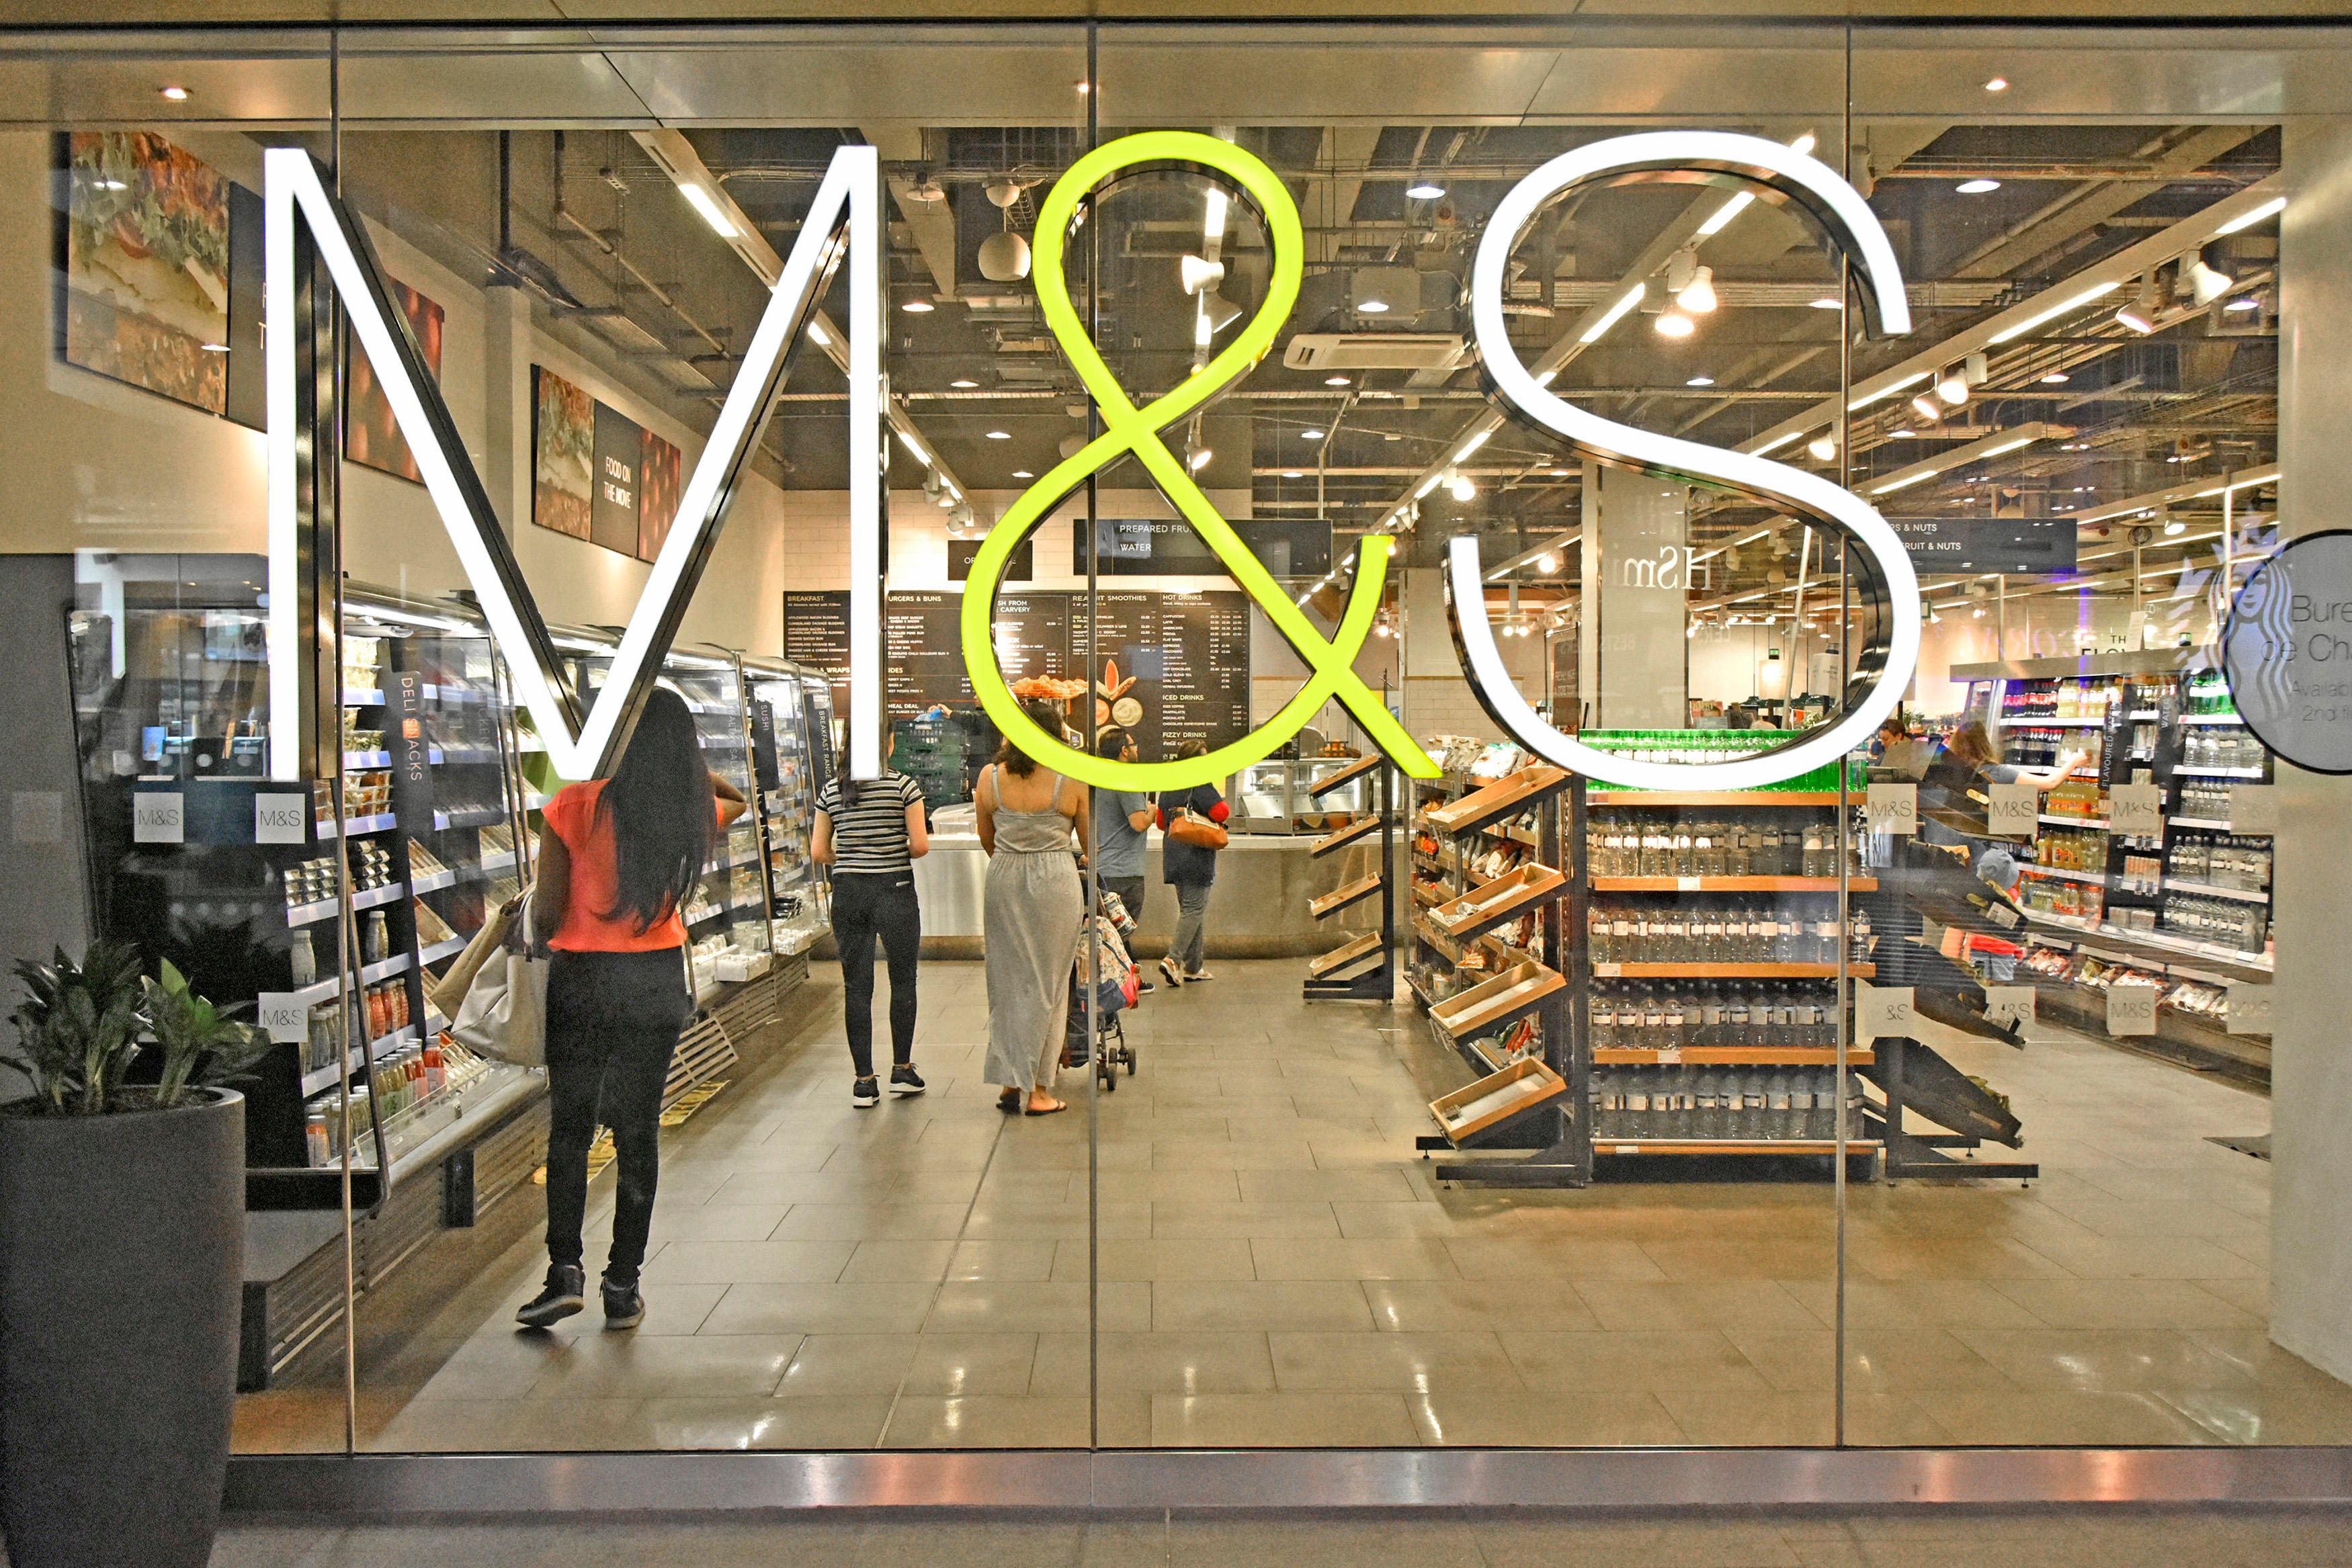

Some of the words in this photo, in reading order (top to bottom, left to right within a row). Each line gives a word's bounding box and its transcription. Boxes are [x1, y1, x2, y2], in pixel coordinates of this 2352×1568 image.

[605, 455, 622, 479] FOOD
[622, 465, 632, 483] ON
[603, 480, 615, 502] THE
[616, 487, 632, 509] MOVE
[1120, 525, 1168, 533] PREPARED
[1171, 525, 1191, 533] FRU
[1913, 524, 1937, 532] NUTS
[1120, 543, 1152, 552] WATER
[2111, 635, 2126, 644] TH
[2308, 634, 2352, 662] Ch
[401, 677, 416, 711] DELI
[760, 704, 769, 731] SUSHI
[2107, 705, 2116, 732] WATER
[2161, 700, 2170, 728] WATER
[818, 710, 829, 752] BREAKFAST
[405, 718, 423, 781] SNACKS
[823, 753, 833, 779] RANGE
[2102, 736, 2113, 787] FLAVOURED
[138, 809, 179, 826] M&S
[1870, 800, 1912, 818] M&S
[1992, 799, 2034, 818] M&S
[2113, 799, 2154, 817] M&S
[259, 809, 301, 827] M&S
[263, 1008, 304, 1027] M&S
[1886, 1004, 1908, 1020] &S
[2008, 1003, 2030, 1019] &S
[2110, 1000, 2152, 1018] M&S
